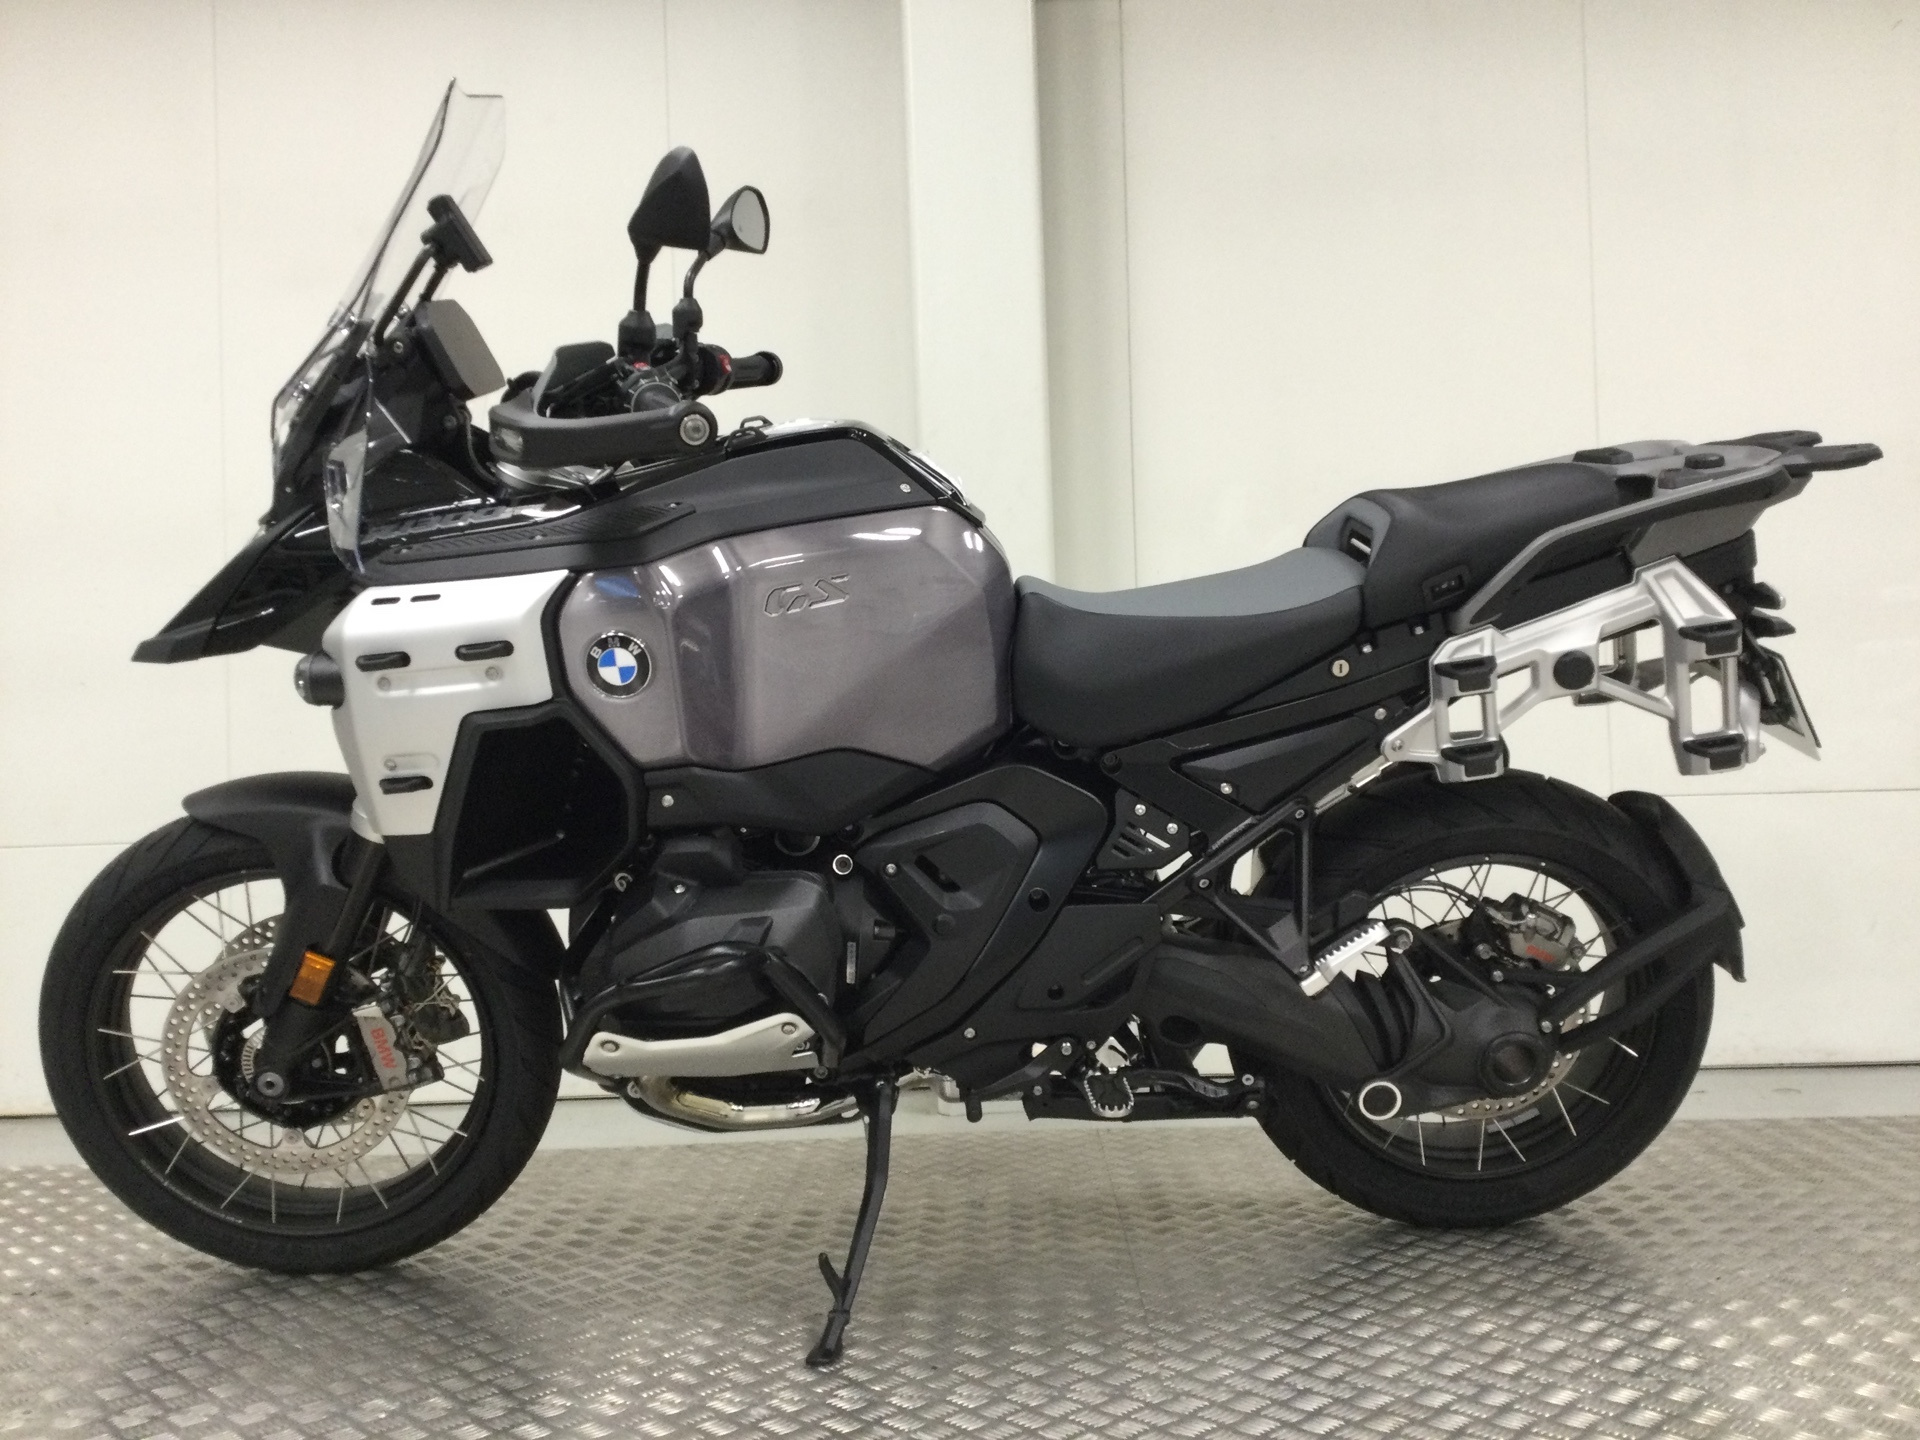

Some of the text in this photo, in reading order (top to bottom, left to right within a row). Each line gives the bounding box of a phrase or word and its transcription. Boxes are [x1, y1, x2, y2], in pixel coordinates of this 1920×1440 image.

[764, 574, 850, 617] GS
[590, 637, 642, 659] BMW
[370, 1028, 397, 1068] BMW
